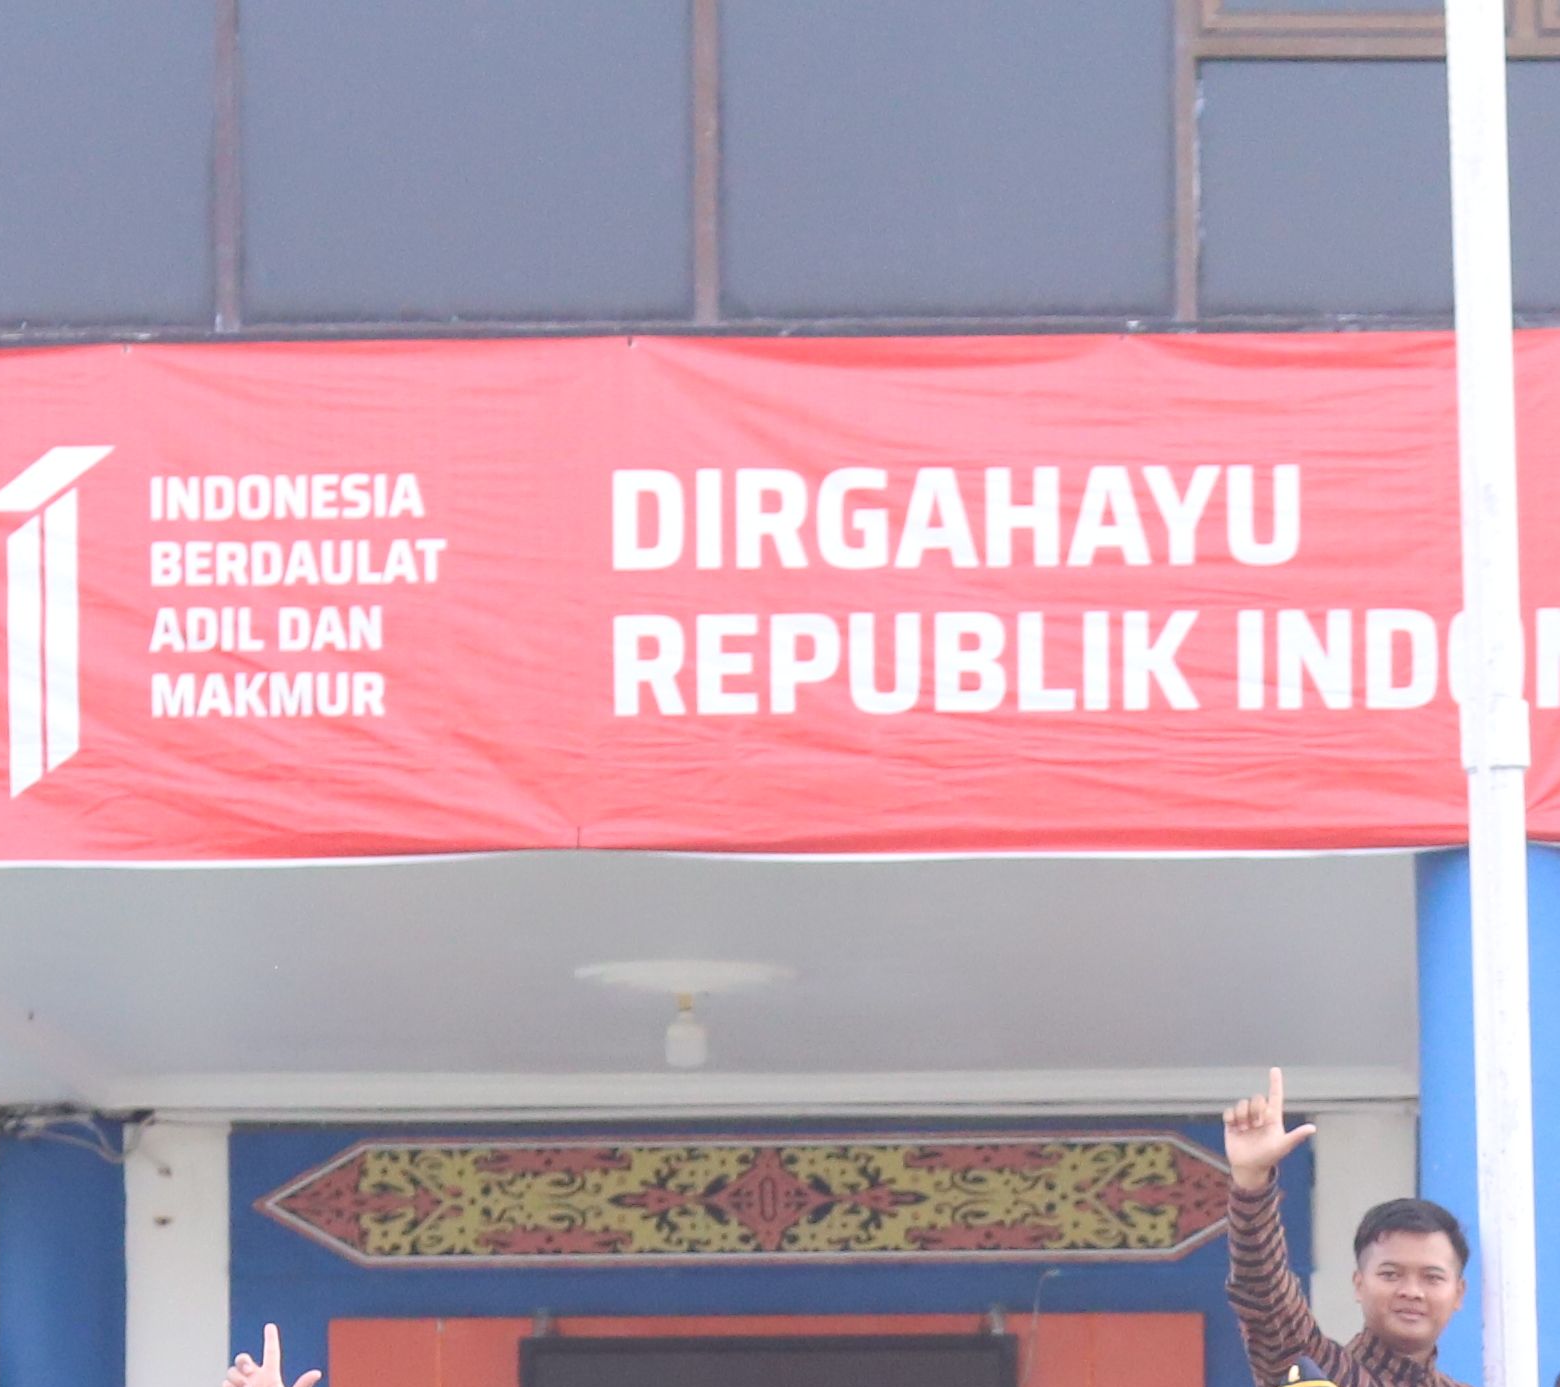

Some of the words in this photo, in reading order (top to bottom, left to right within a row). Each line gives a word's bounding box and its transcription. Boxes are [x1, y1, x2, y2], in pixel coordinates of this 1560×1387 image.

[150, 474, 425, 521] INDONESIA
[612, 464, 1301, 571] DIRGAHAYU
[150, 539, 447, 586] BERDAULAT
[149, 606, 265, 652] ADIL
[278, 606, 383, 652] DAN
[613, 610, 1200, 717] REPUBLIK
[150, 672, 385, 718] MAKMUR
